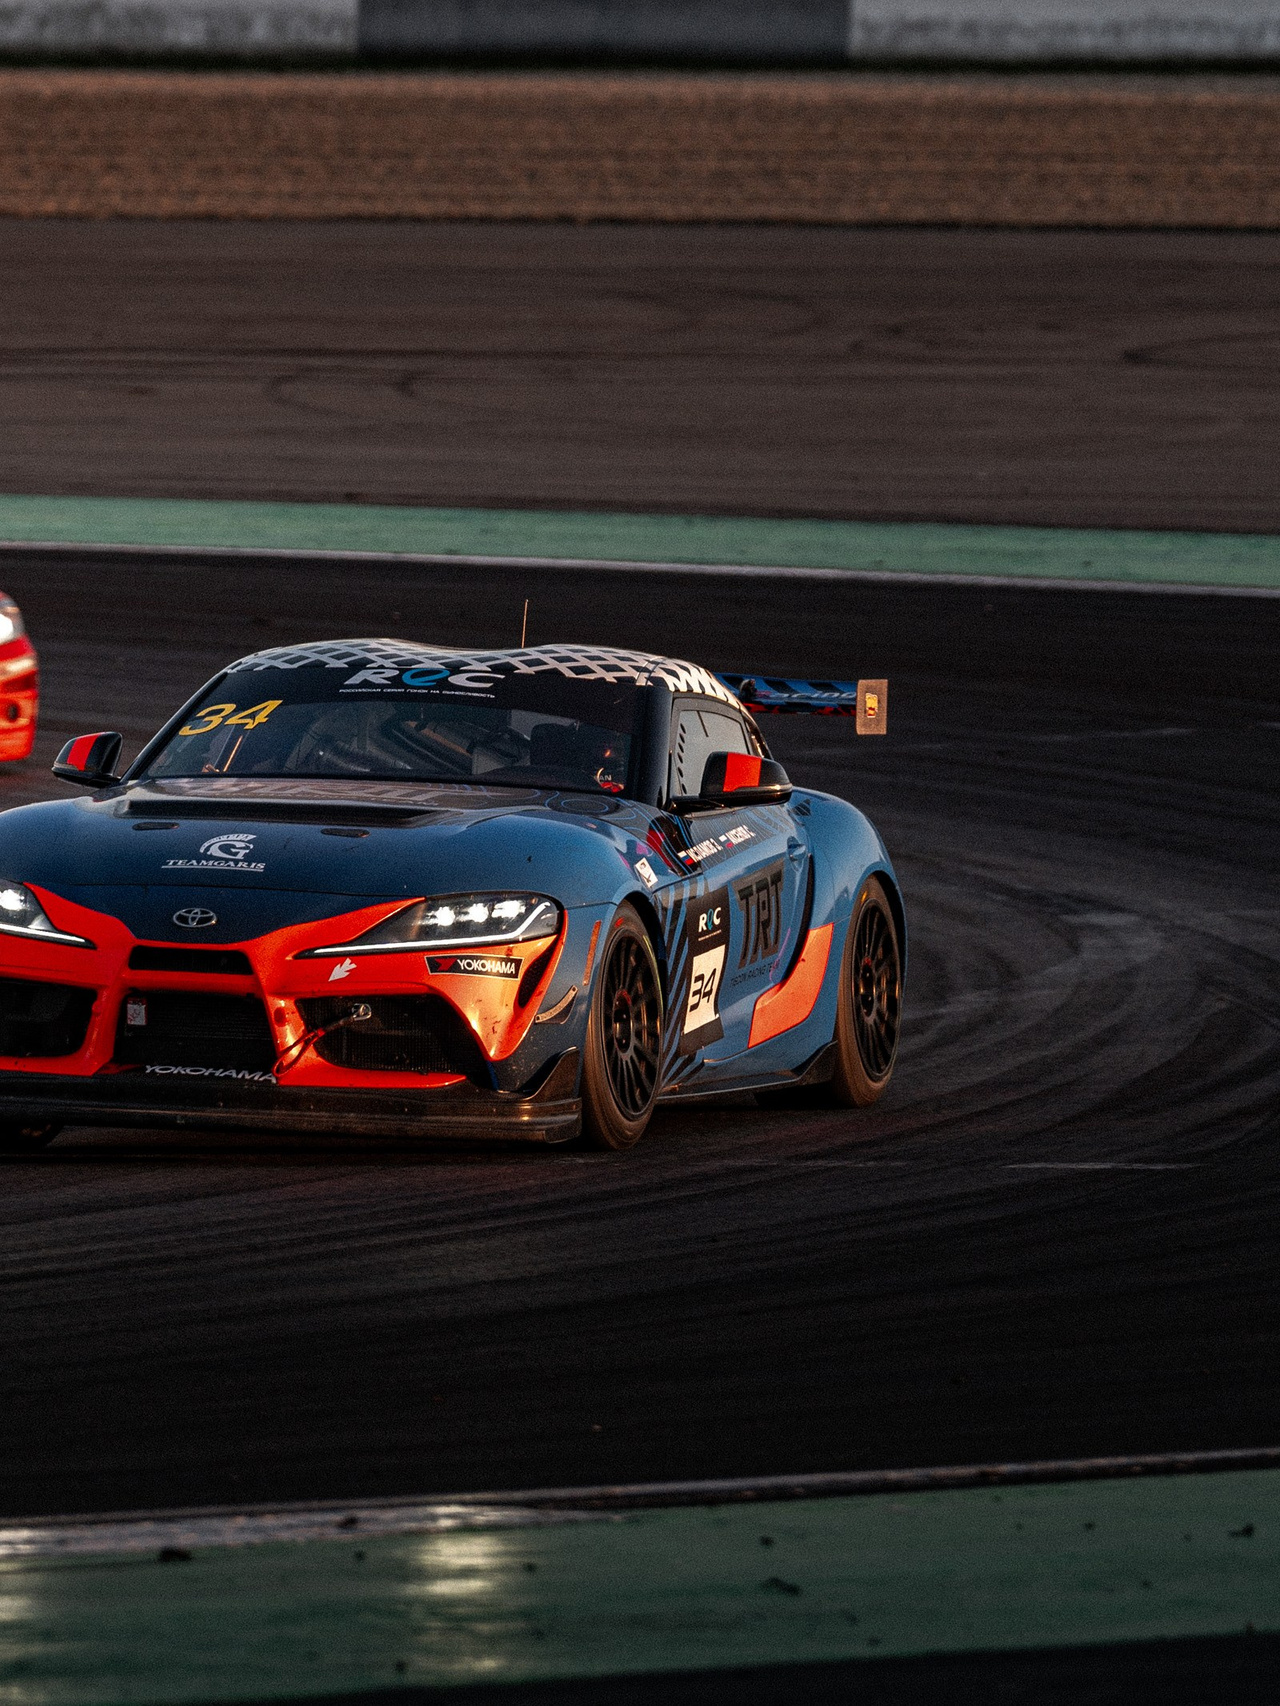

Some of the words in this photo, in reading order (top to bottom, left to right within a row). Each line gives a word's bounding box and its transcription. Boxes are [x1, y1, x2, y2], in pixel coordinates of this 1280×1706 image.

[179, 700, 283, 735] 34
[165, 859, 266, 870] TEAMGARIS
[457, 959, 516, 975] YOKOHAMA
[688, 967, 717, 1013] 34
[145, 1065, 277, 1084] YOKOHAMA
